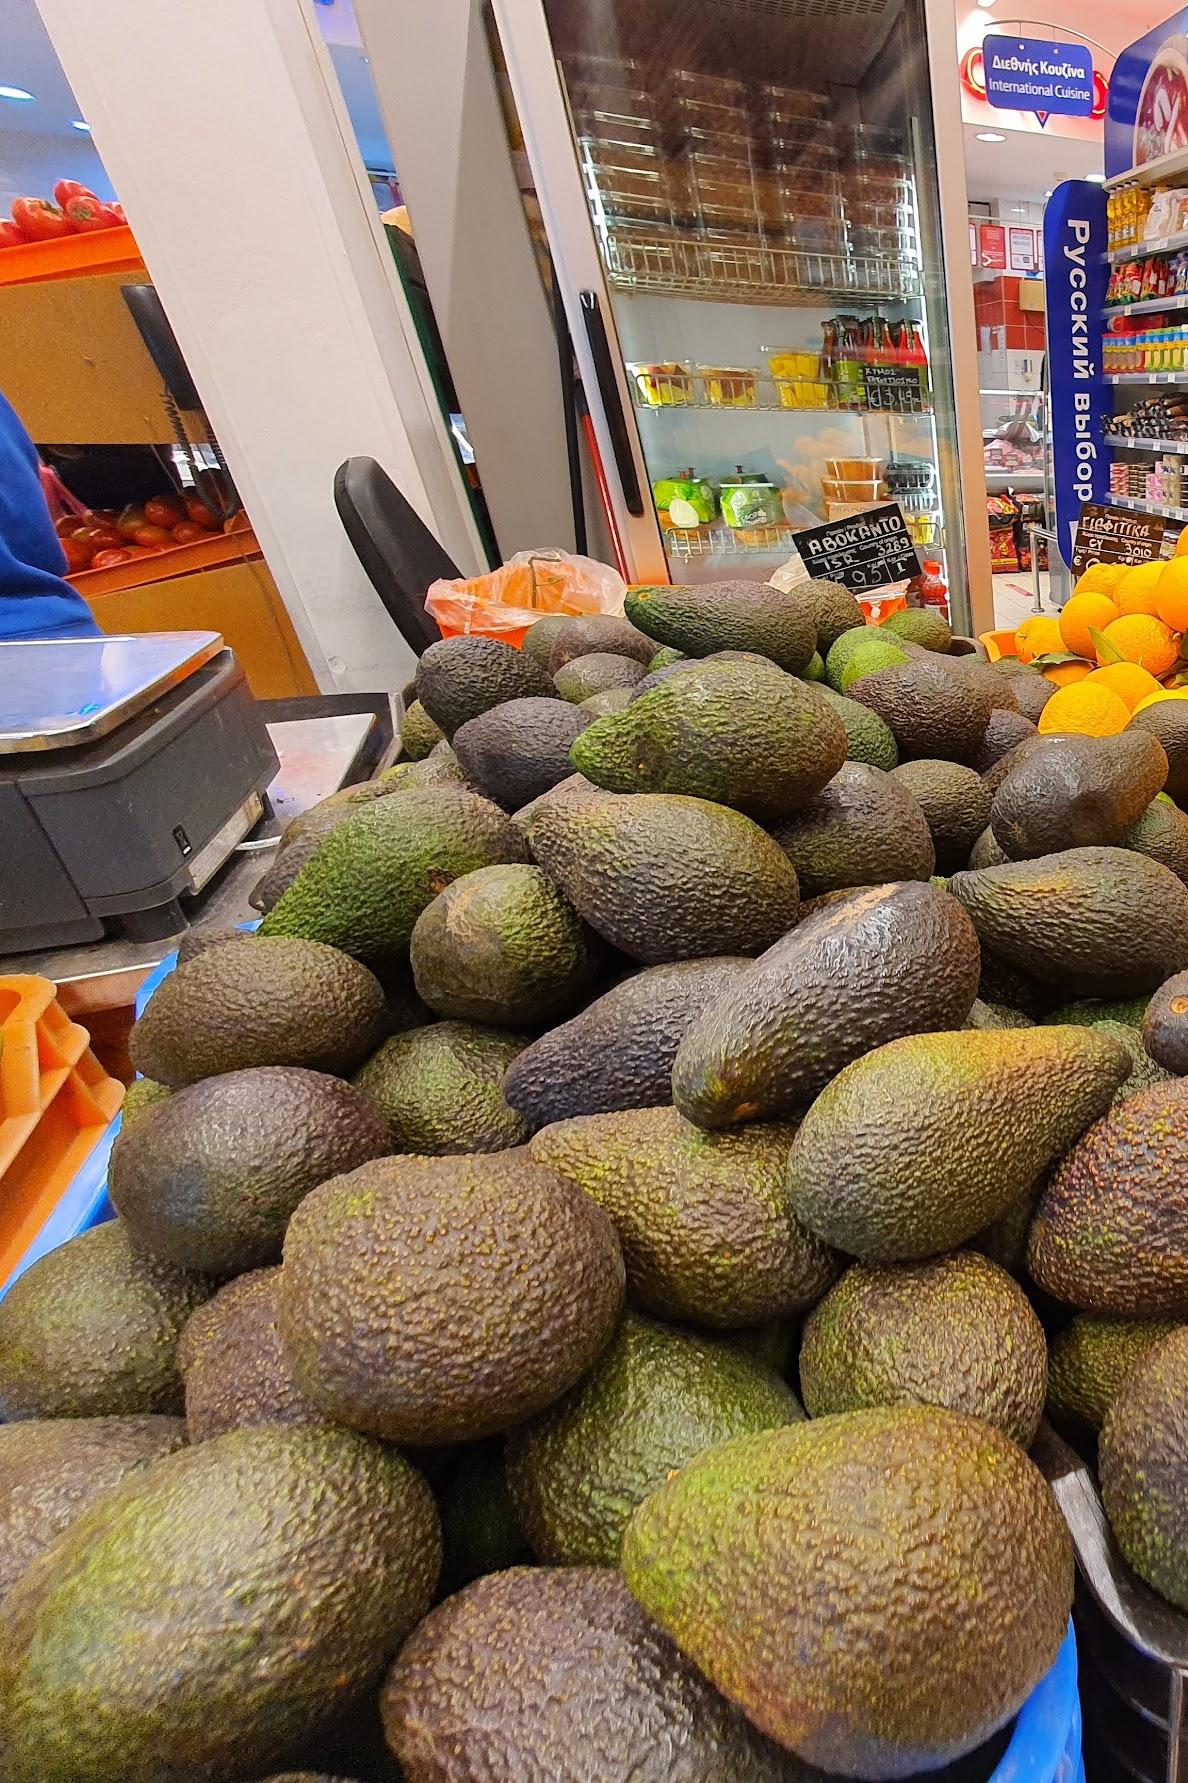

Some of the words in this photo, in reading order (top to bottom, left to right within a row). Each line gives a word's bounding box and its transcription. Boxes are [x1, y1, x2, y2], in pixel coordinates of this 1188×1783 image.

[991, 55, 1039, 76] Διεθνής
[1040, 60, 1086, 79] Κουζίνα
[988, 78, 1053, 97] International
[1054, 85, 1091, 100] Cuisine
[1064, 219, 1095, 379] Русский
[1072, 393, 1097, 502] выбор
[1124, 543, 1152, 557] 3010
